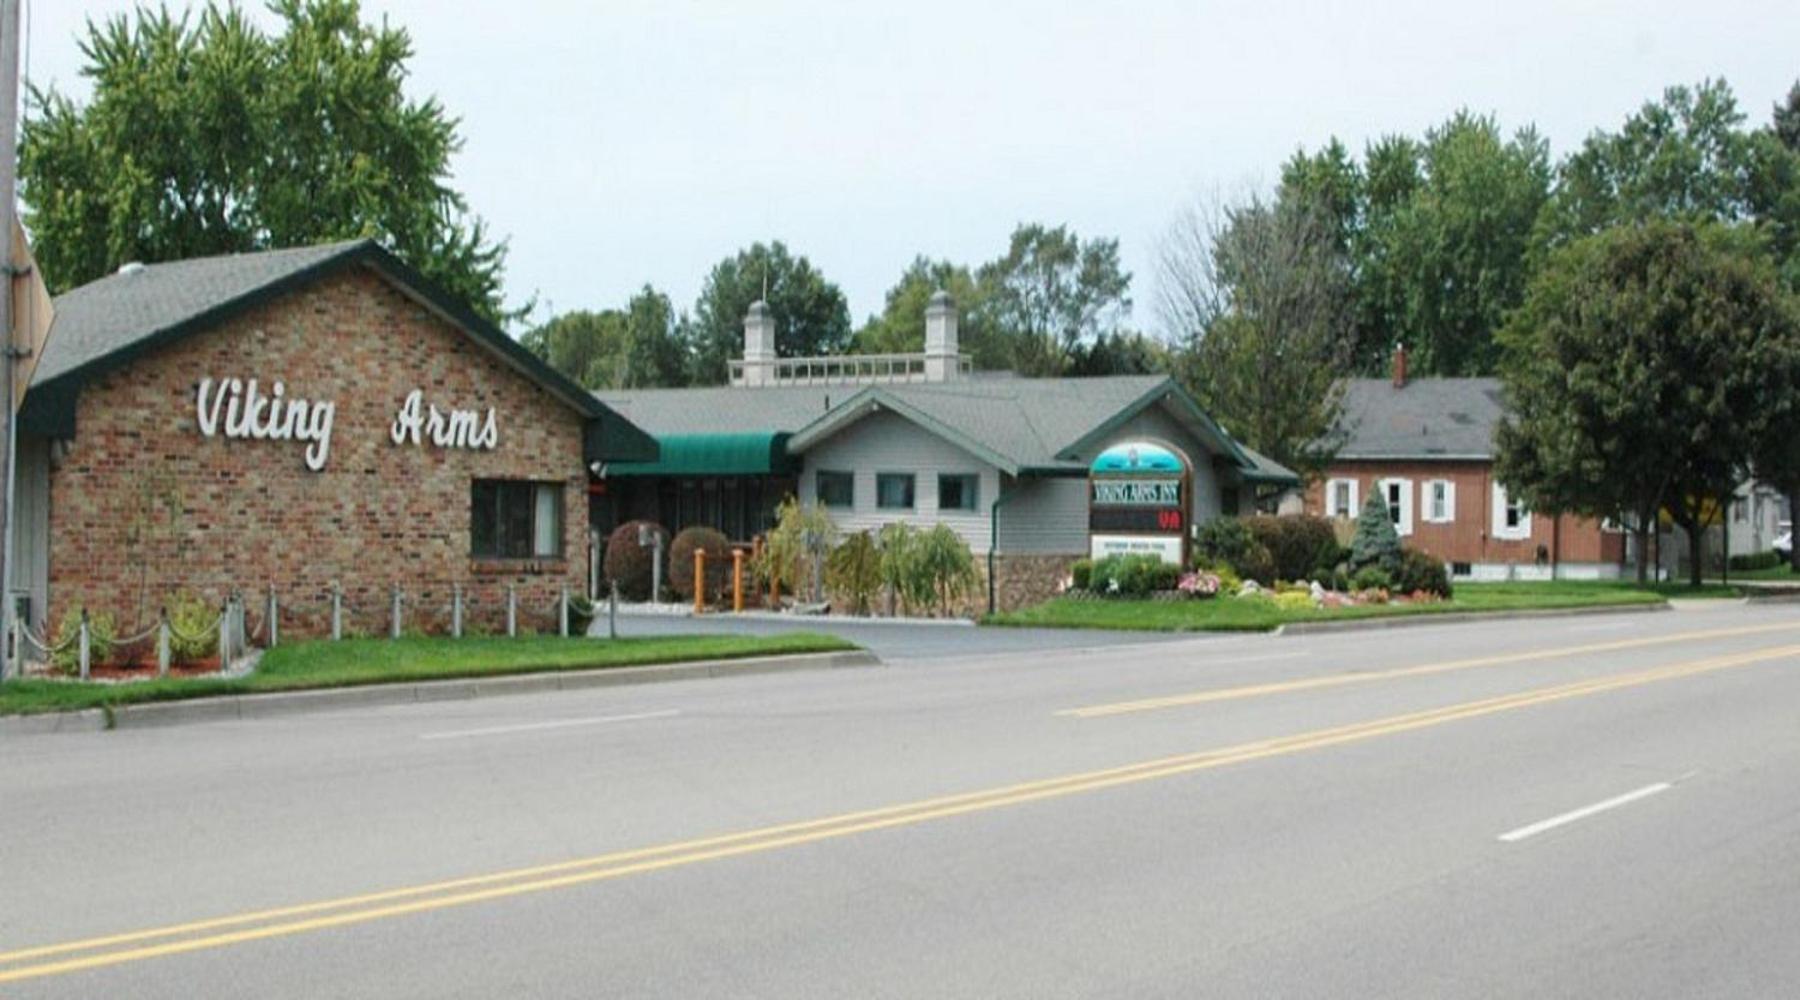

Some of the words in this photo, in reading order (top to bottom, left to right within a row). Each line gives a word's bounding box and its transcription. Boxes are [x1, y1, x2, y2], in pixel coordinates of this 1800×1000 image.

[197, 377, 336, 470] Viking
[391, 389, 498, 448] Arms
[1094, 482, 1128, 503] VIKING
[1129, 482, 1157, 503] ARMS
[1160, 482, 1179, 504] INN
